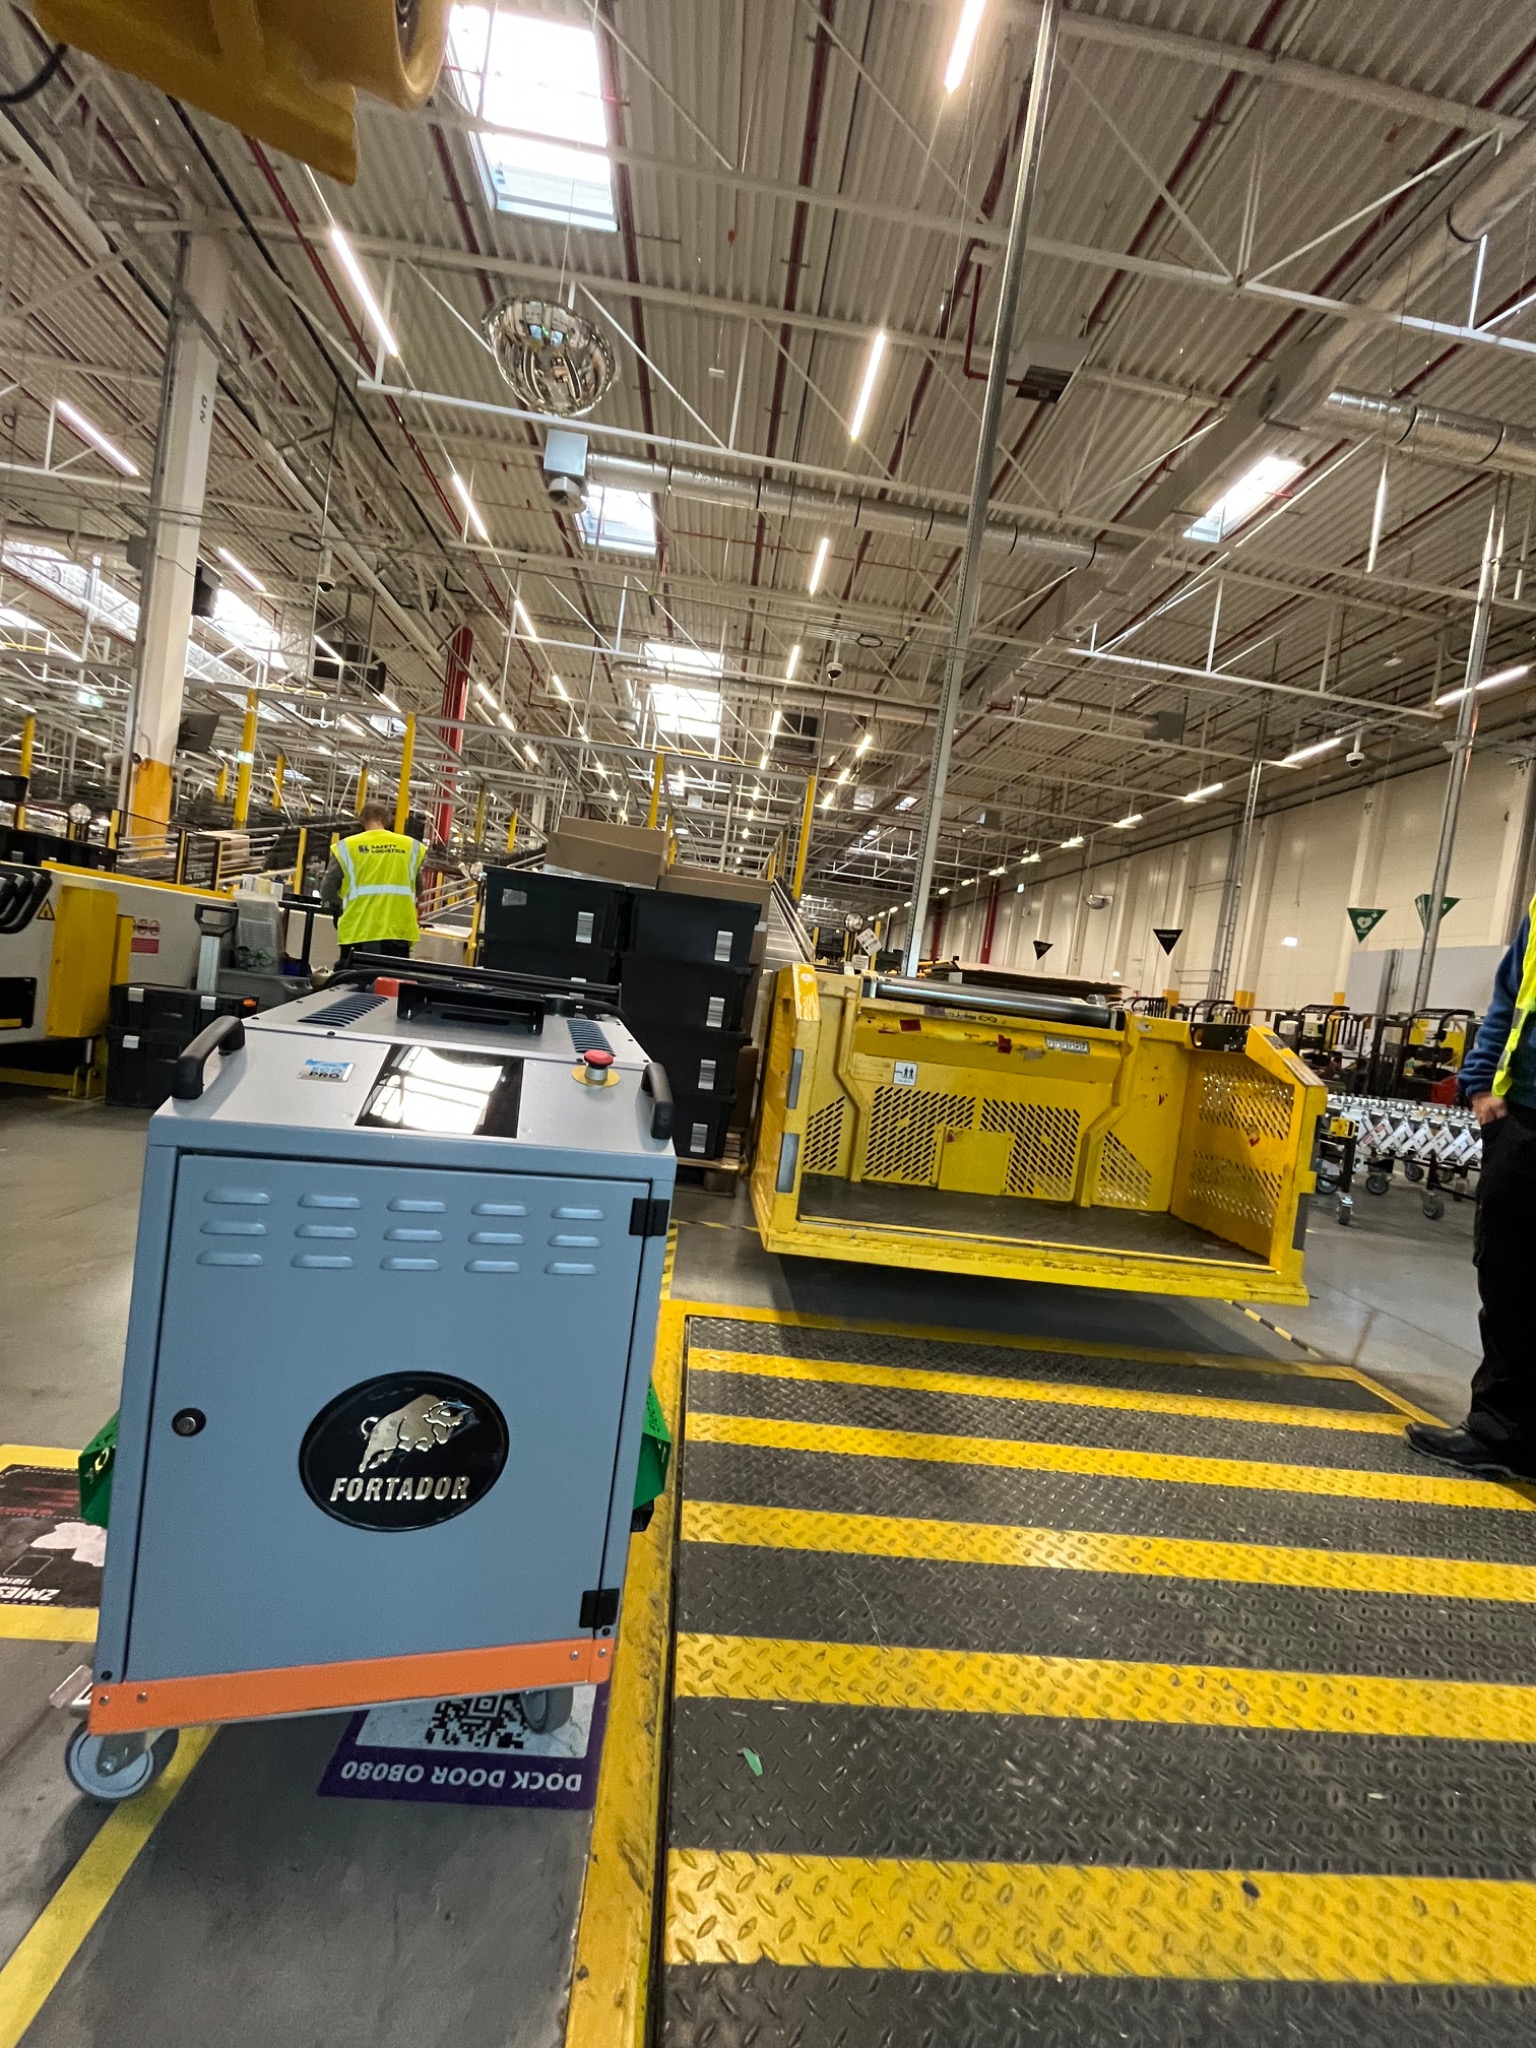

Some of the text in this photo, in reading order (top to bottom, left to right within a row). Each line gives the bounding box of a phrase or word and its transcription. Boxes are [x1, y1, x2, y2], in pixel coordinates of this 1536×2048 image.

[309, 1071, 340, 1079] PRO
[329, 1476, 471, 1502] FORTADOR
[340, 1761, 583, 1792] DOCK DOOR OB080
